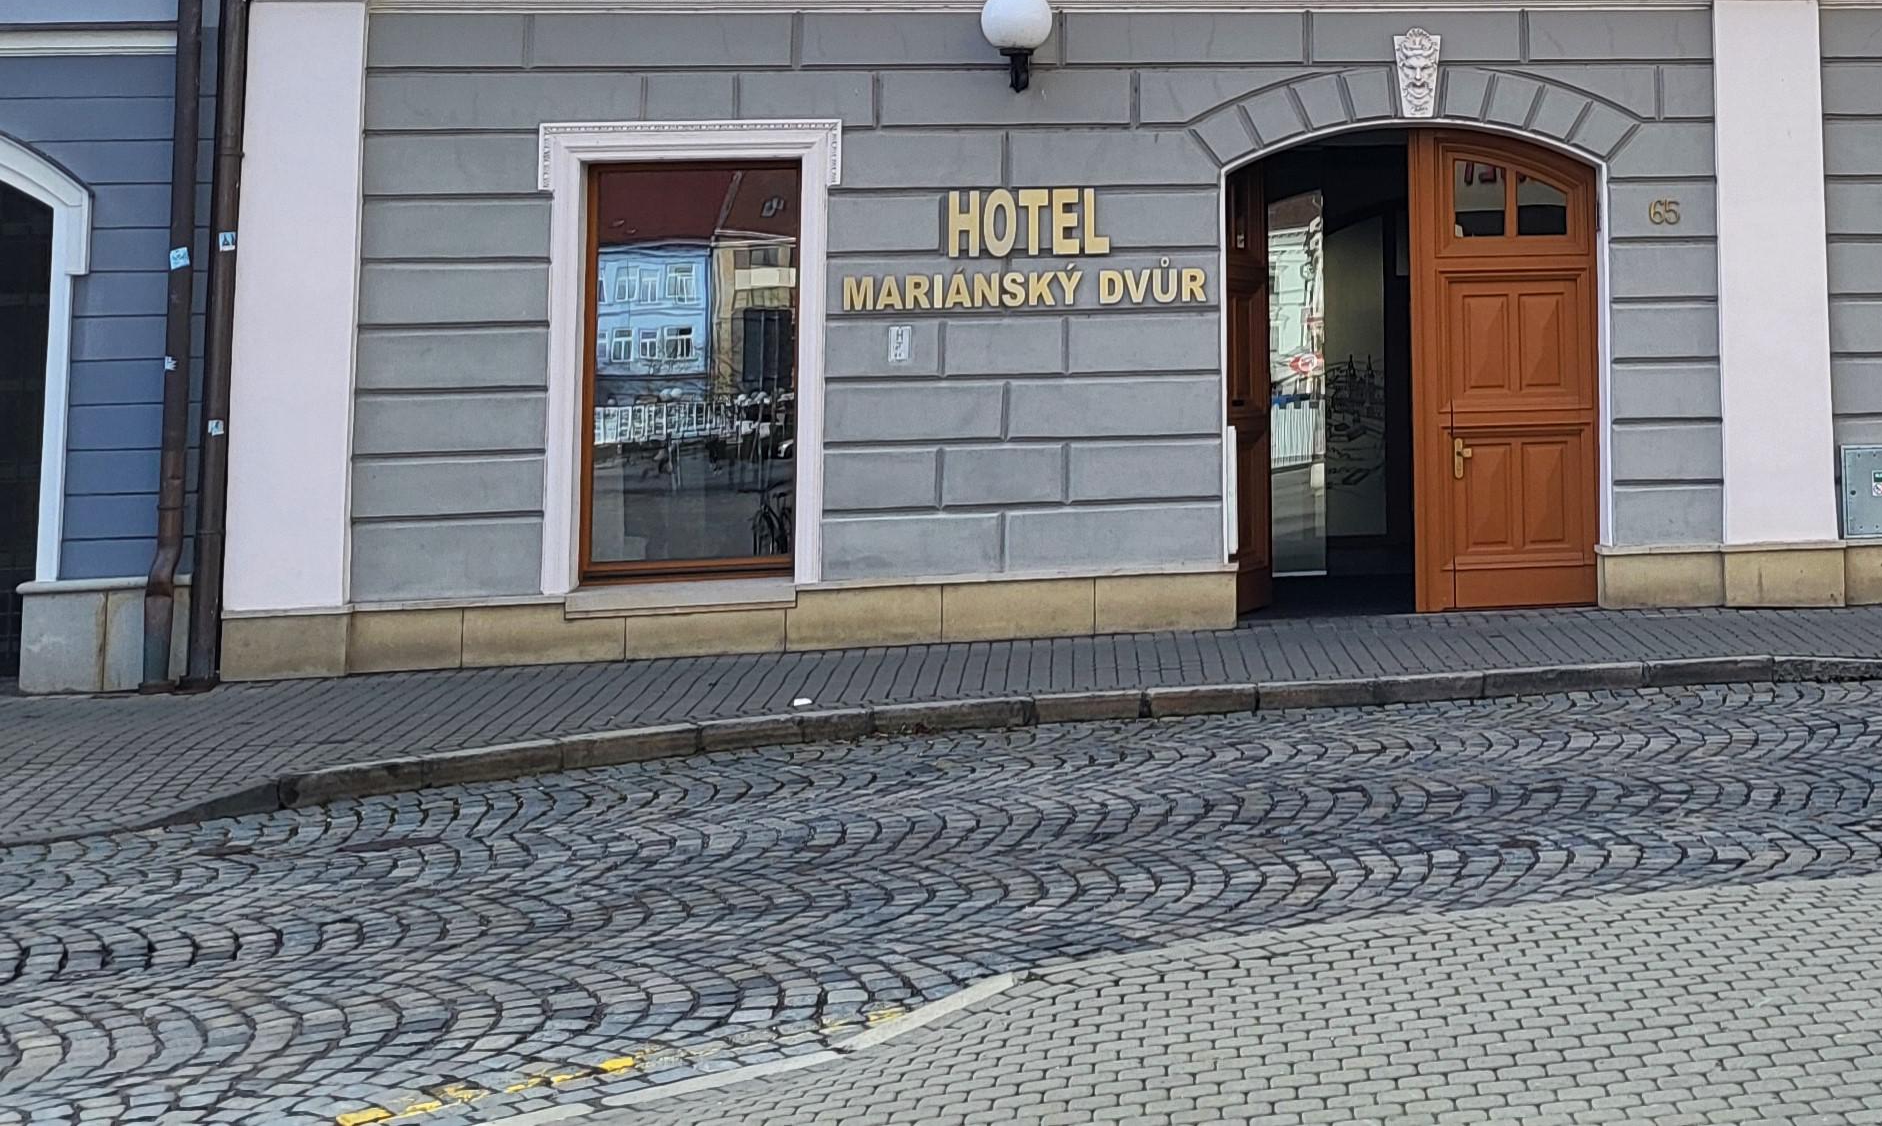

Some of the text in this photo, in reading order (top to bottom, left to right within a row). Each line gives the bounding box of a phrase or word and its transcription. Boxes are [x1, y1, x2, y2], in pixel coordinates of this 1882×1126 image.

[947, 188, 1111, 258] HOTEL
[1649, 199, 1681, 225] 65
[842, 257, 1208, 311] MARIÁNSKÝ DVŮR
